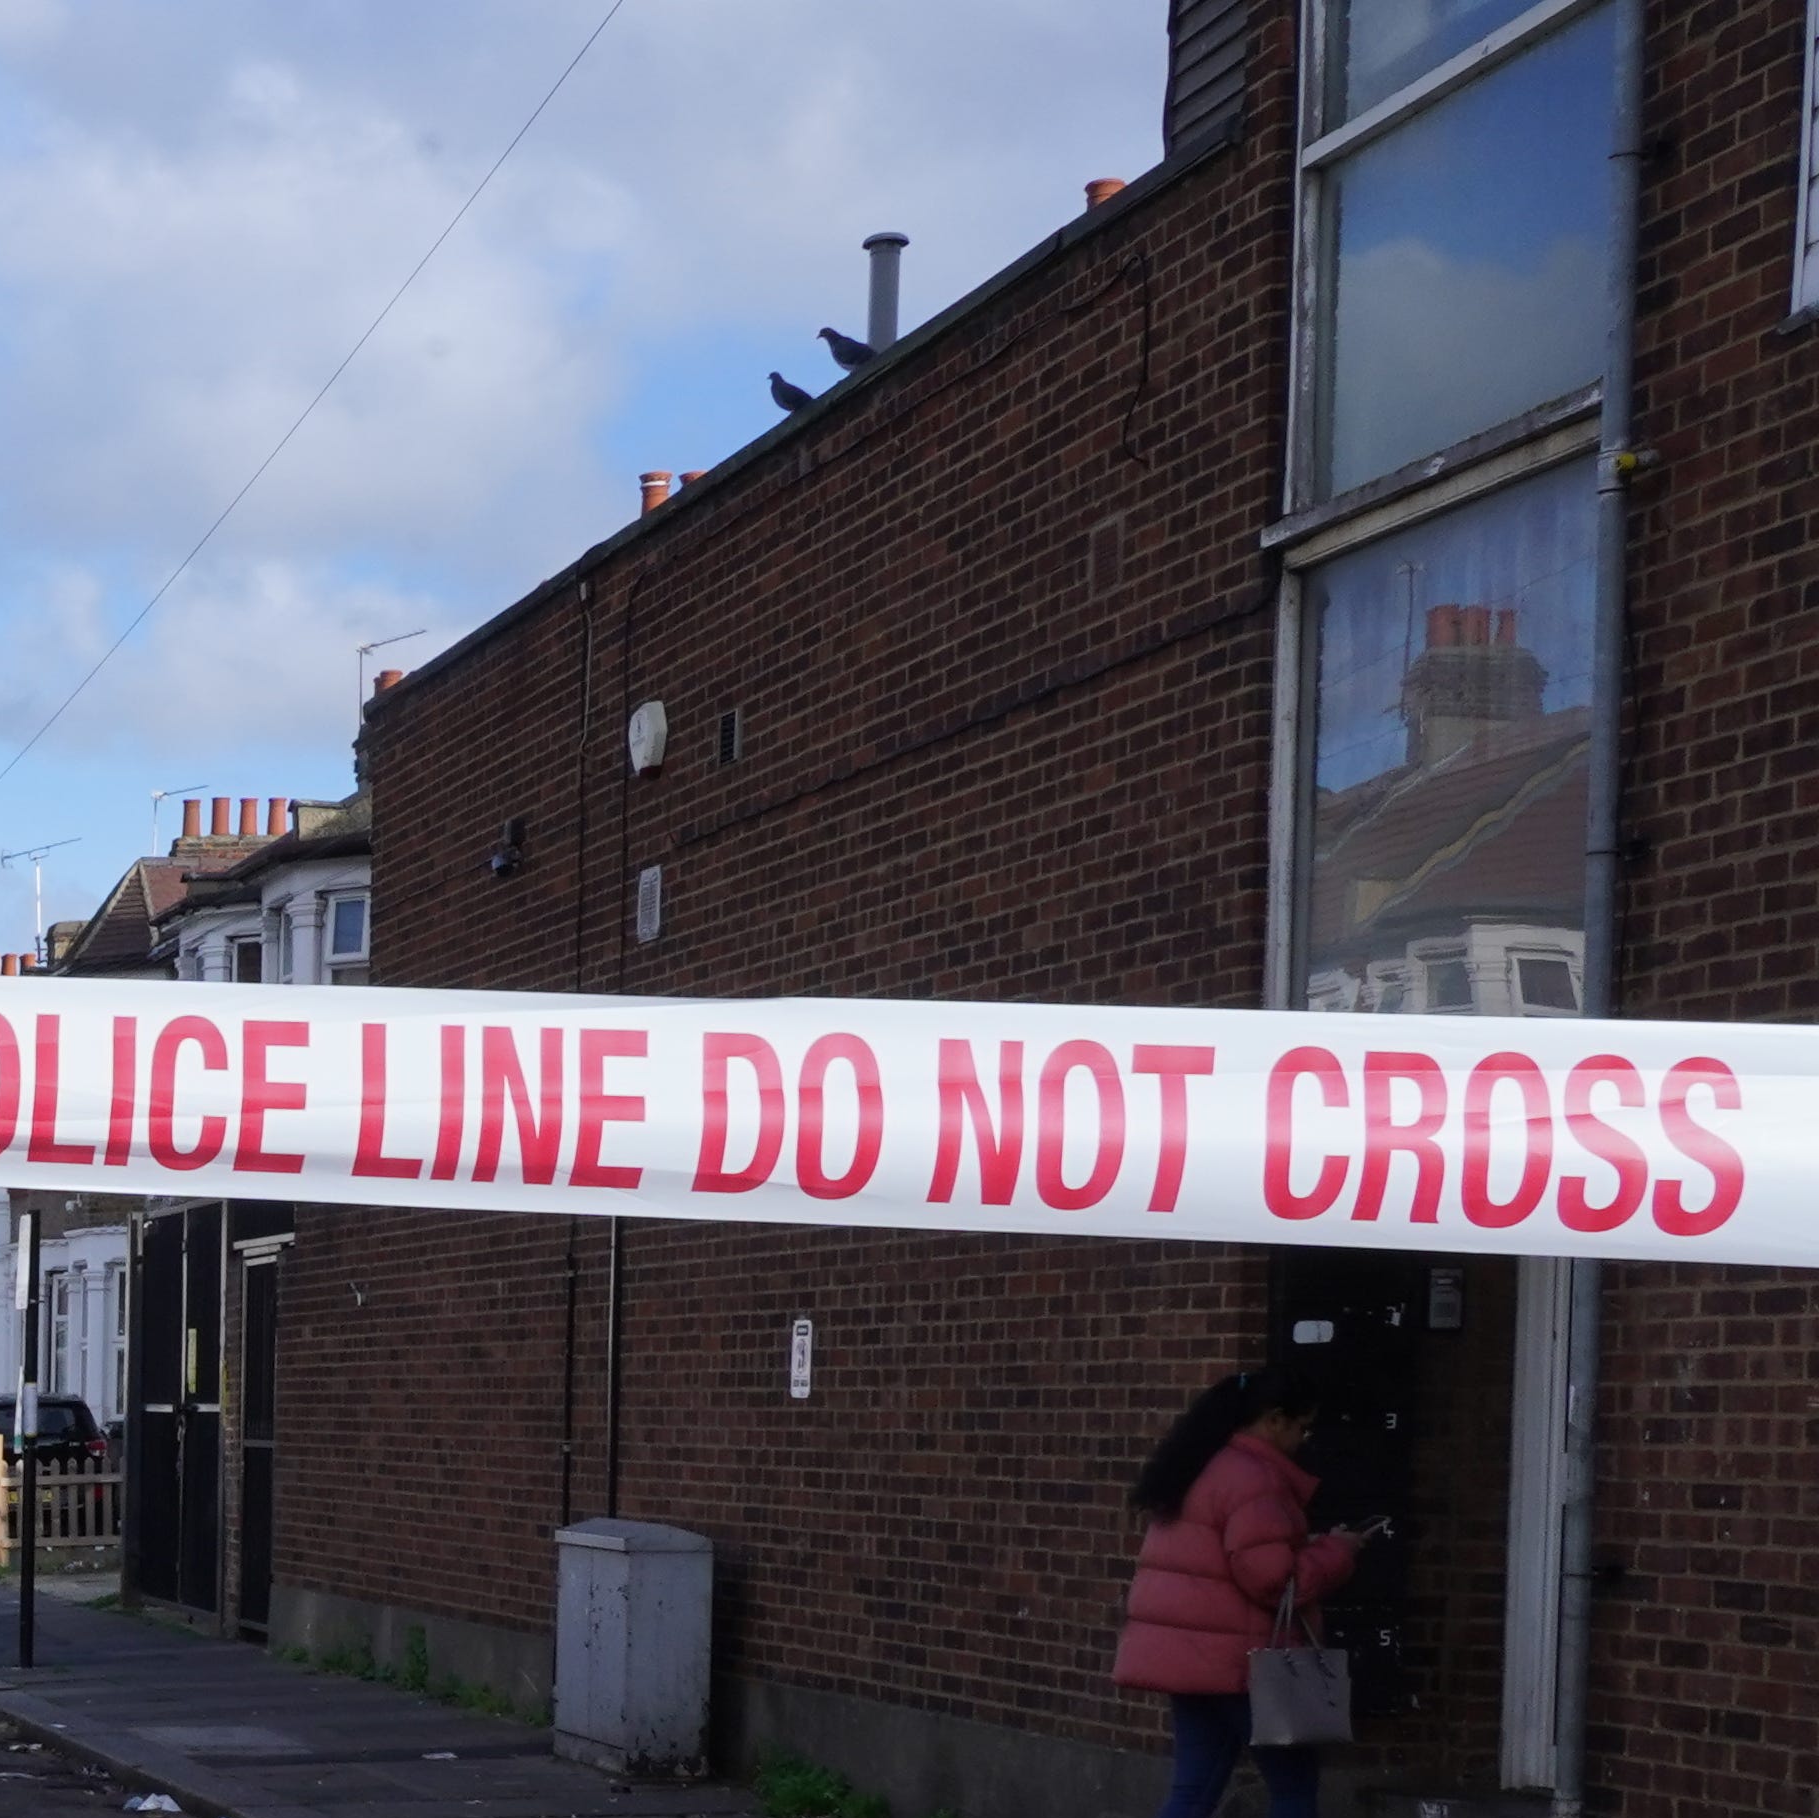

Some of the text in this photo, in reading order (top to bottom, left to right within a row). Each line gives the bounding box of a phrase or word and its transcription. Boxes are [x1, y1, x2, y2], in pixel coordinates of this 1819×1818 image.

[349, 1021, 650, 1190] LINE
[691, 1030, 884, 1201] DO
[924, 1037, 1216, 1213] NOT
[1263, 1045, 1746, 1238] CROSS
[1386, 1413, 1397, 1429] 3
